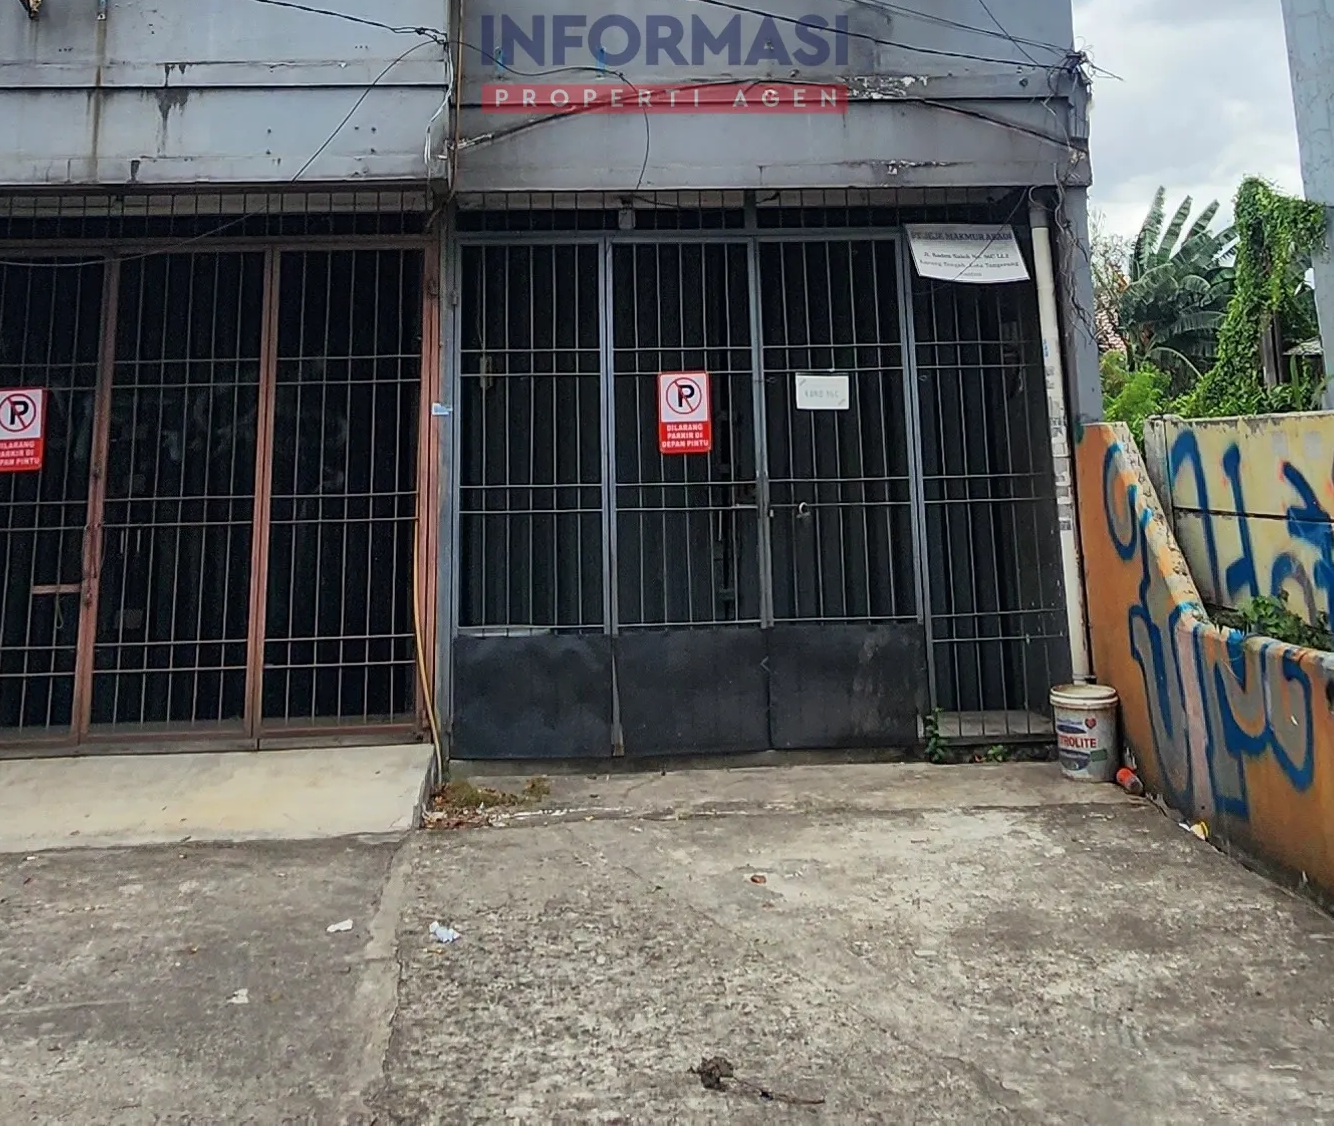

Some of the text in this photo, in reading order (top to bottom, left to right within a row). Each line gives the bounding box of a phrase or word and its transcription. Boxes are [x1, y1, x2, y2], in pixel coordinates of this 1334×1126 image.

[662, 439, 709, 448] DEPAN PINTU
[16, 457, 41, 465] PINTU
